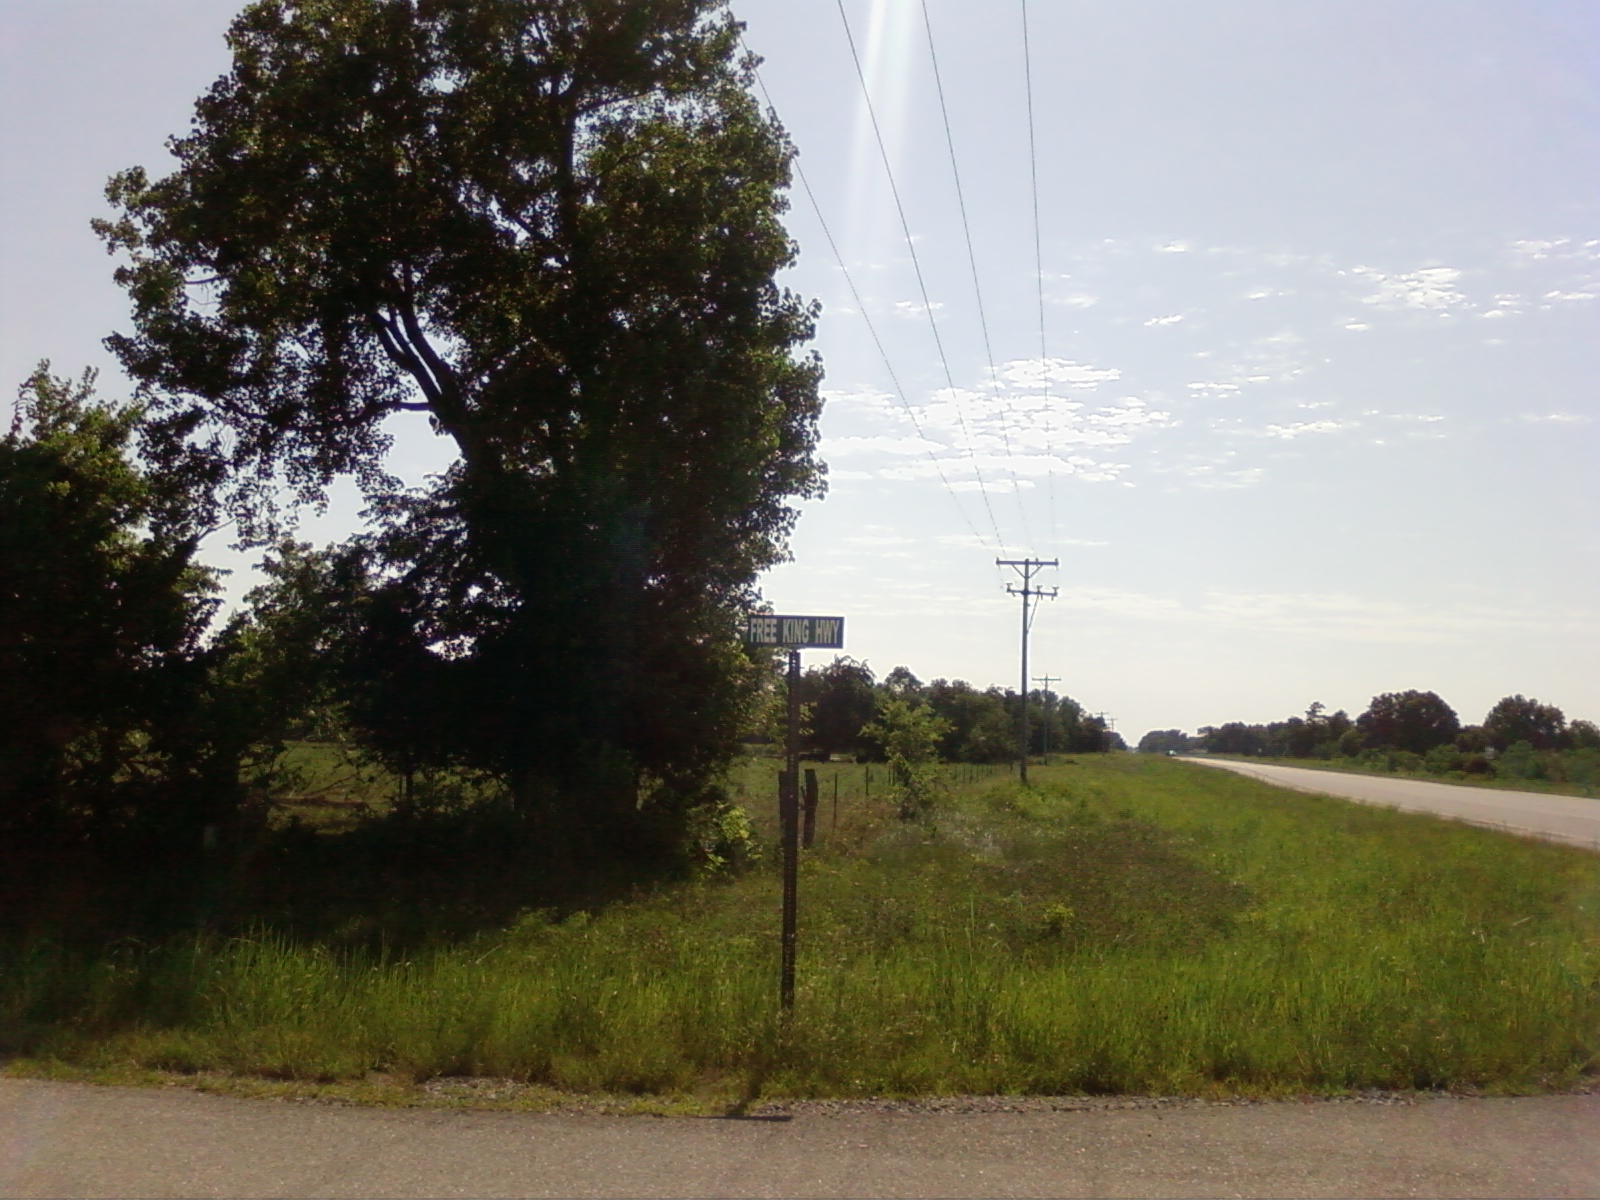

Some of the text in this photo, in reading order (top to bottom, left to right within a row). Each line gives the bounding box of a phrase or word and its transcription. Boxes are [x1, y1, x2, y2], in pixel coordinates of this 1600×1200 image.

[750, 618, 840, 644] FREE KING HWY
